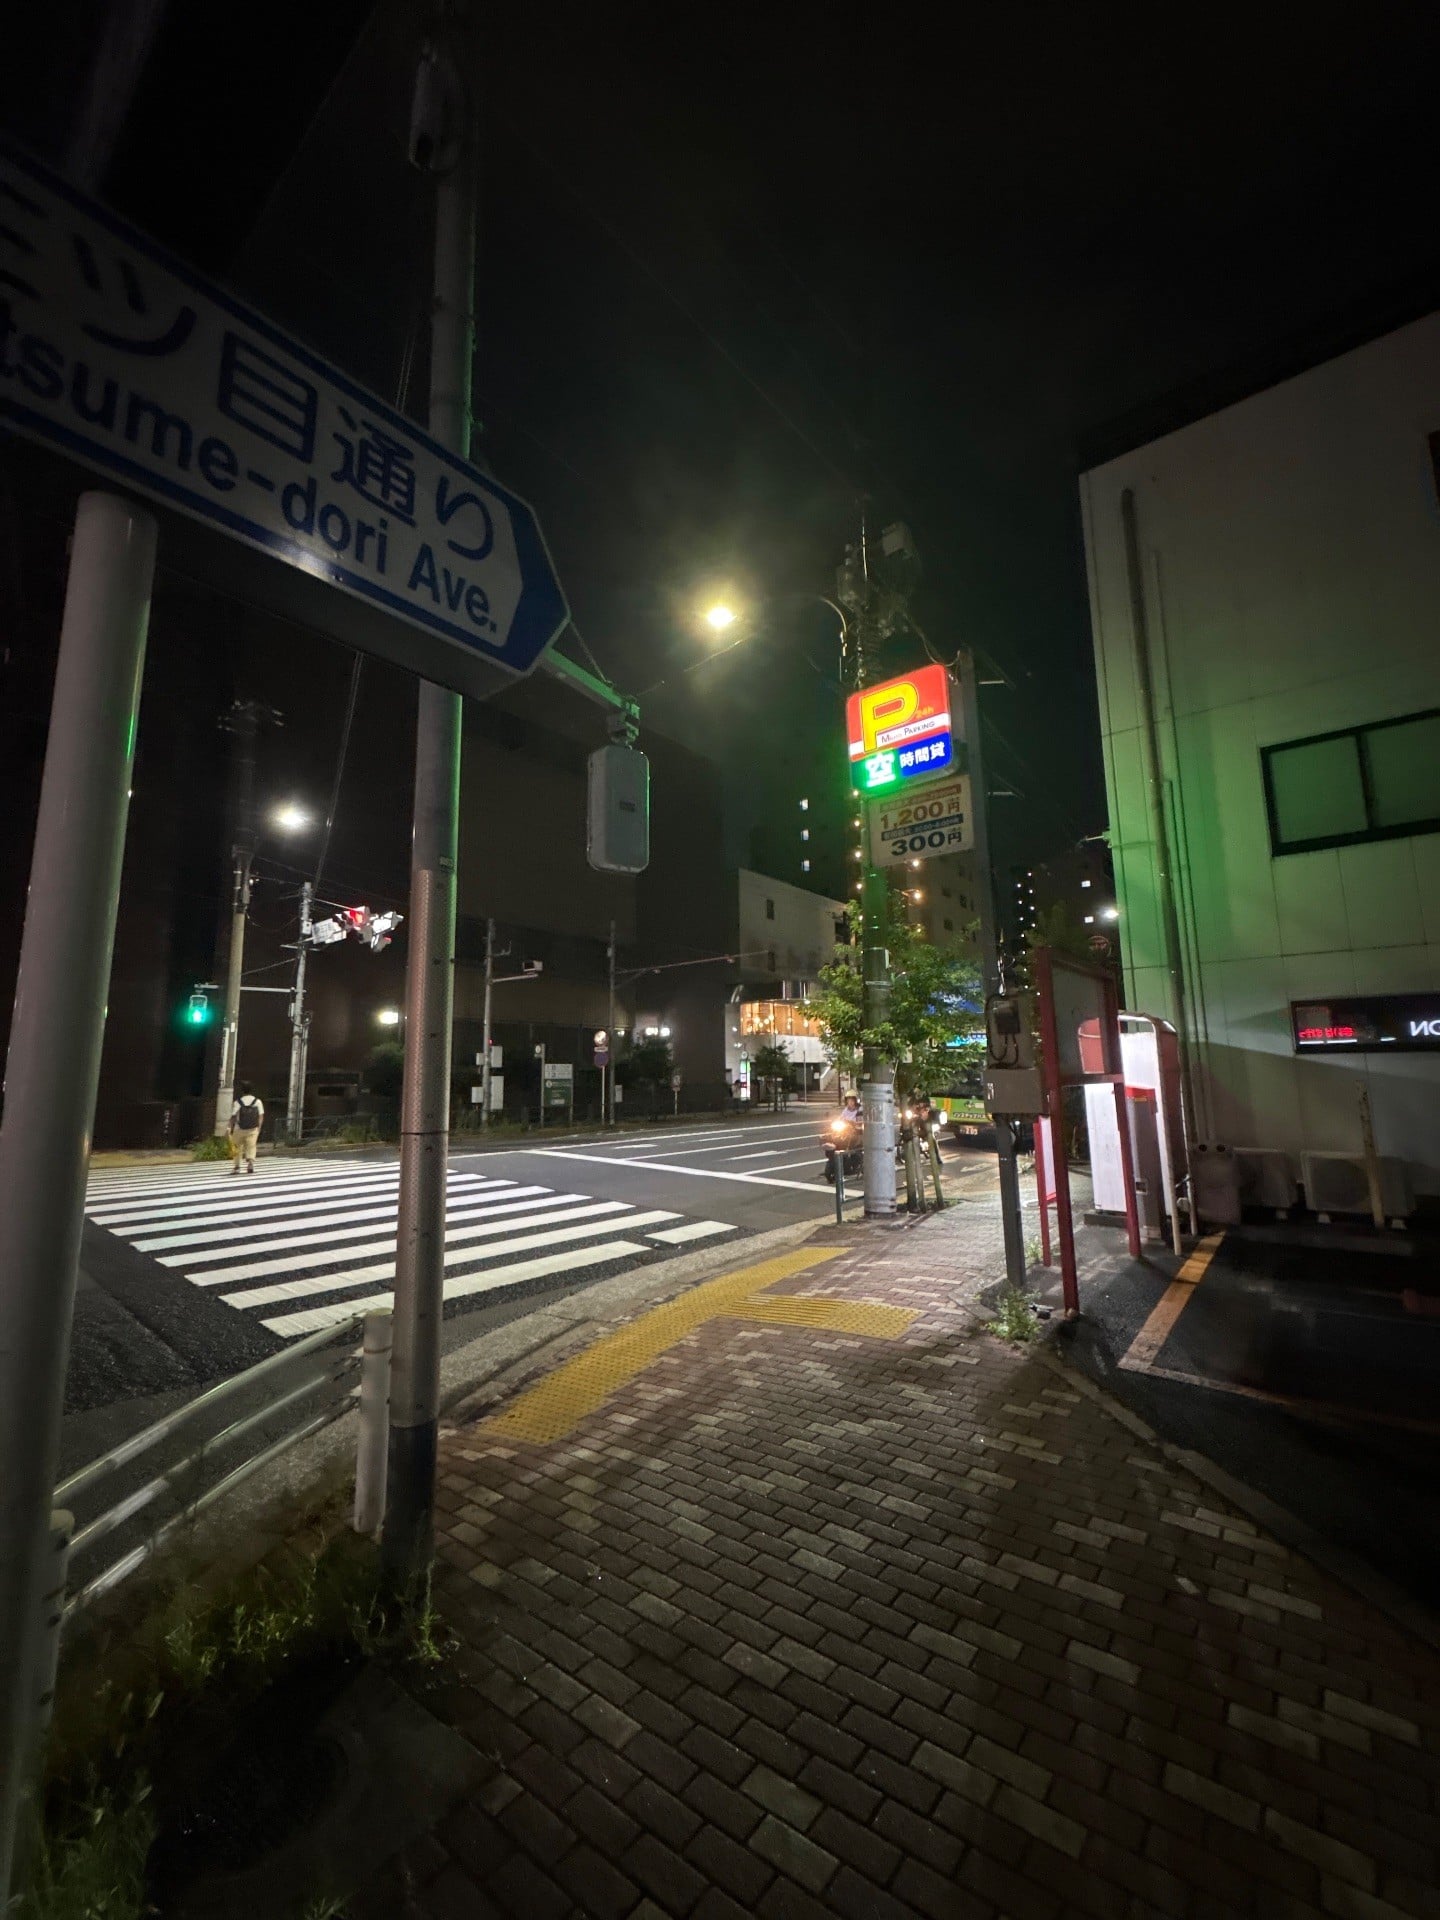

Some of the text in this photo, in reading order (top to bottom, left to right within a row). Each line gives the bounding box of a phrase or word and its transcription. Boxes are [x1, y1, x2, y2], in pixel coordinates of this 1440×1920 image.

[407, 544, 497, 633] Ave.
[862, 683, 918, 752] P
[865, 741, 945, 787] 空 時間貸
